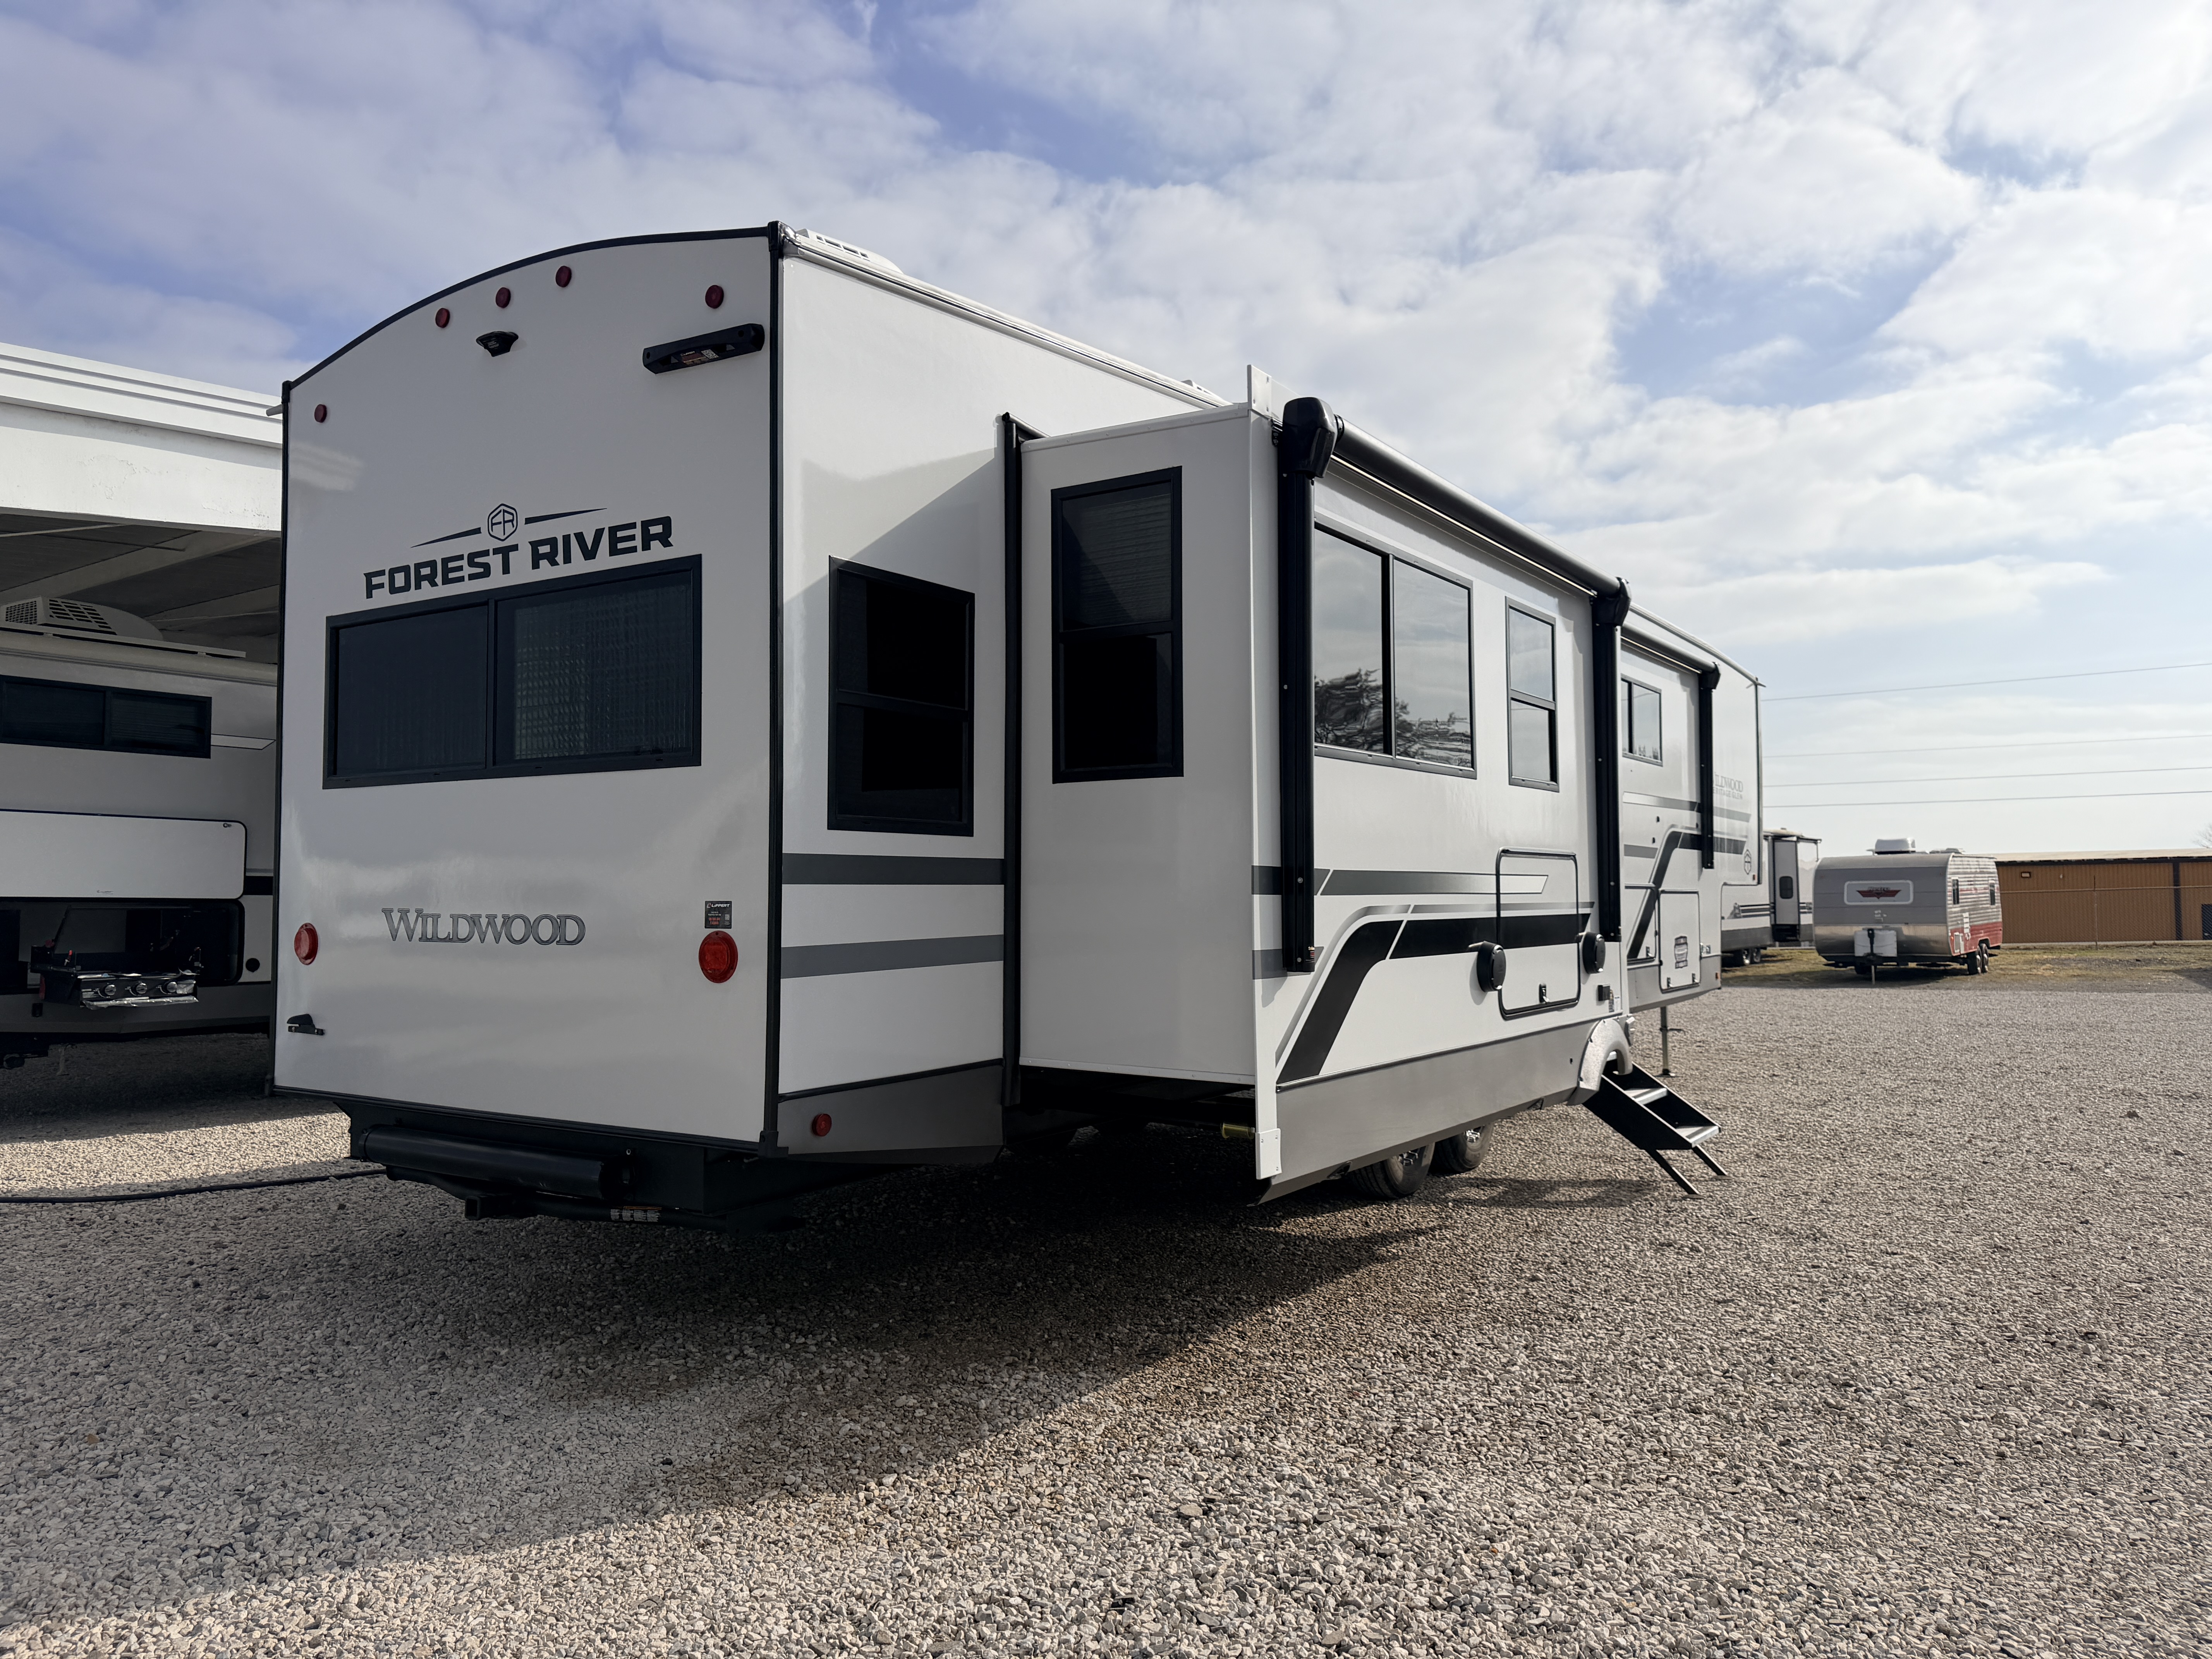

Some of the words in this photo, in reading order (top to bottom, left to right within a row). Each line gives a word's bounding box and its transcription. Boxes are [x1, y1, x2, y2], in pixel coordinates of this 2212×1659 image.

[363, 543, 519, 599] FOREST
[527, 515, 674, 570] RIVER
[1714, 771, 1743, 793] ILDWOOD
[381, 908, 586, 946] WILDWOOD
